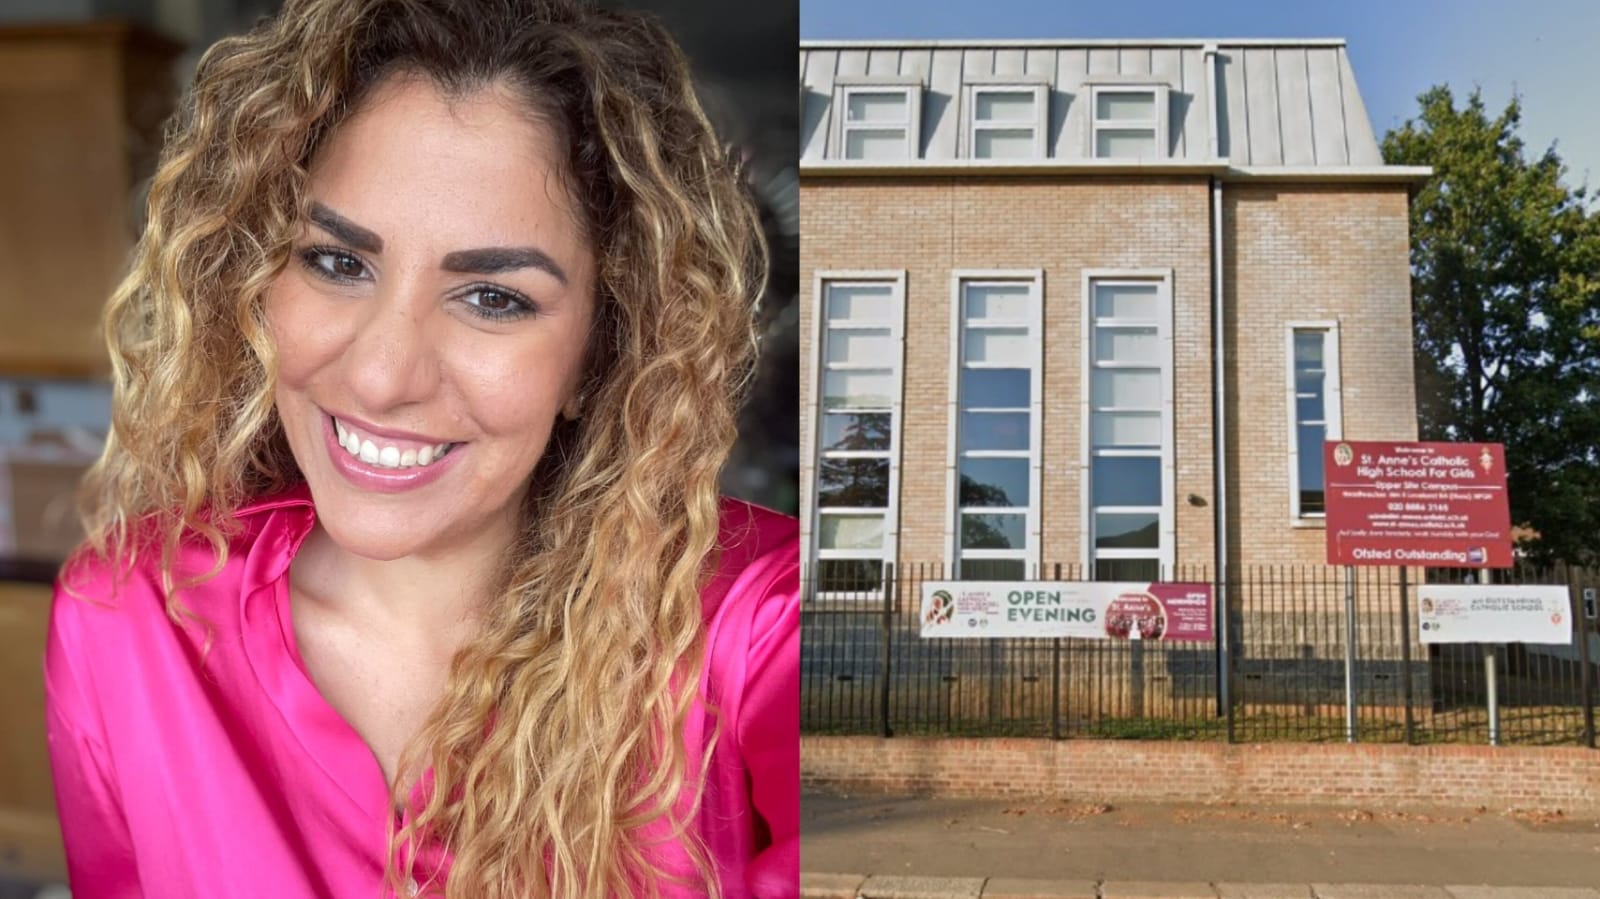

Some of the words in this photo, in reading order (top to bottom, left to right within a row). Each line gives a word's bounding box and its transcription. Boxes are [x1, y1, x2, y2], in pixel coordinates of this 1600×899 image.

[1360, 455, 1374, 465] St.
[1378, 455, 1417, 466] Anne's
[1420, 455, 1470, 466] Catholic
[1357, 466, 1384, 478] High
[1386, 467, 1427, 477] School
[1429, 468, 1447, 477] For
[1450, 468, 1475, 478] Girls
[1376, 481, 1402, 491] Upper
[1403, 481, 1420, 490] Site
[1421, 482, 1458, 491] Campus
[1387, 502, 1403, 511] 020
[1352, 548, 1392, 559] Ofsted
[1394, 548, 1467, 563] Outstanding
[1007, 590, 1061, 605] OPEN
[1007, 607, 1097, 623] EVENING
